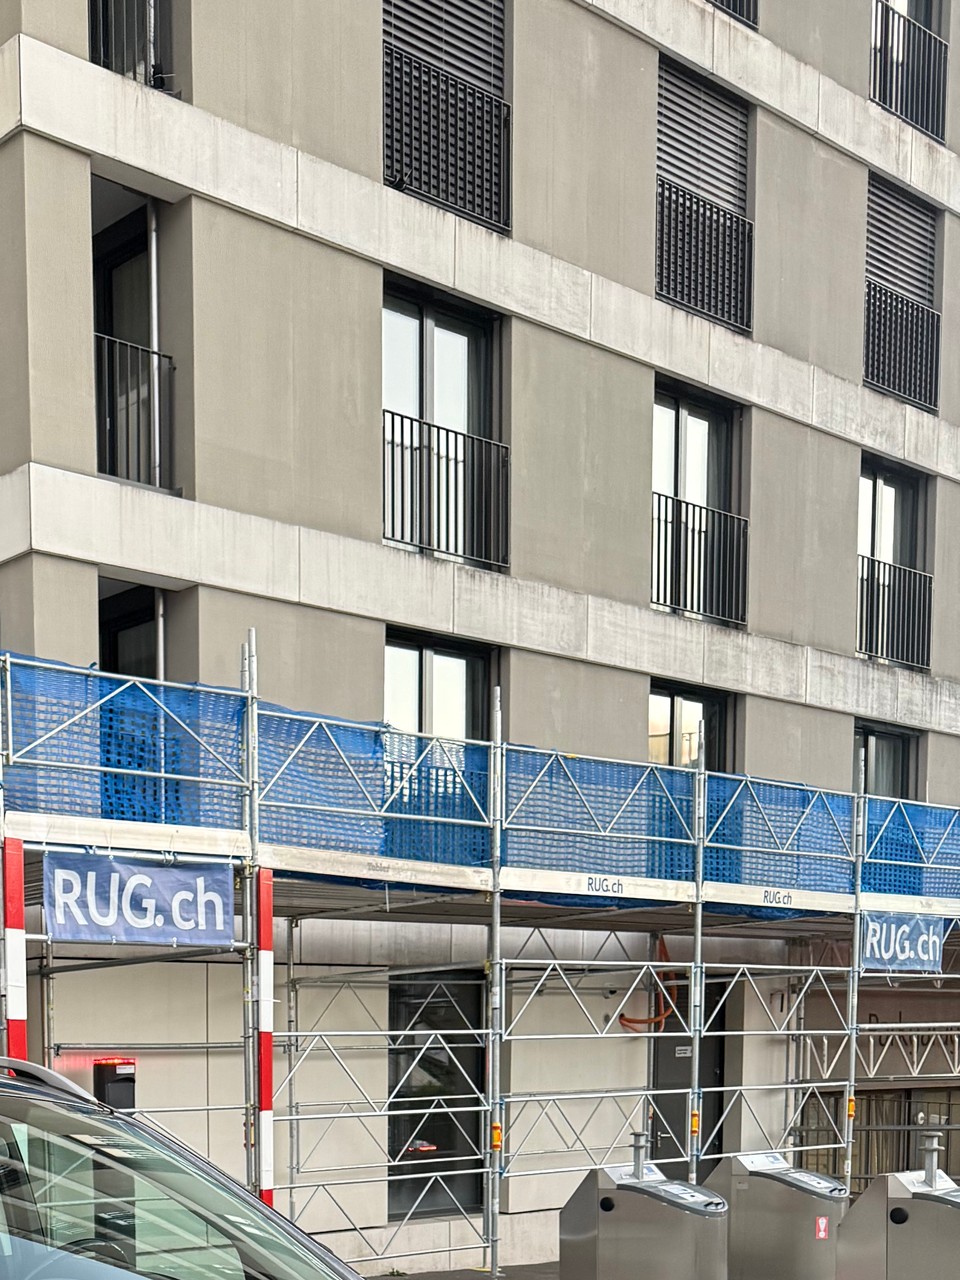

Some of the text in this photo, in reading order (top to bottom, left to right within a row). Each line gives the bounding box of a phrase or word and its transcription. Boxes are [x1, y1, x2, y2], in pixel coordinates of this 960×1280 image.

[54, 868, 225, 931] RUG.ch
[587, 876, 624, 894] RUG.ch
[763, 889, 793, 906] RUG.ch
[865, 921, 941, 961] RUG.ch
